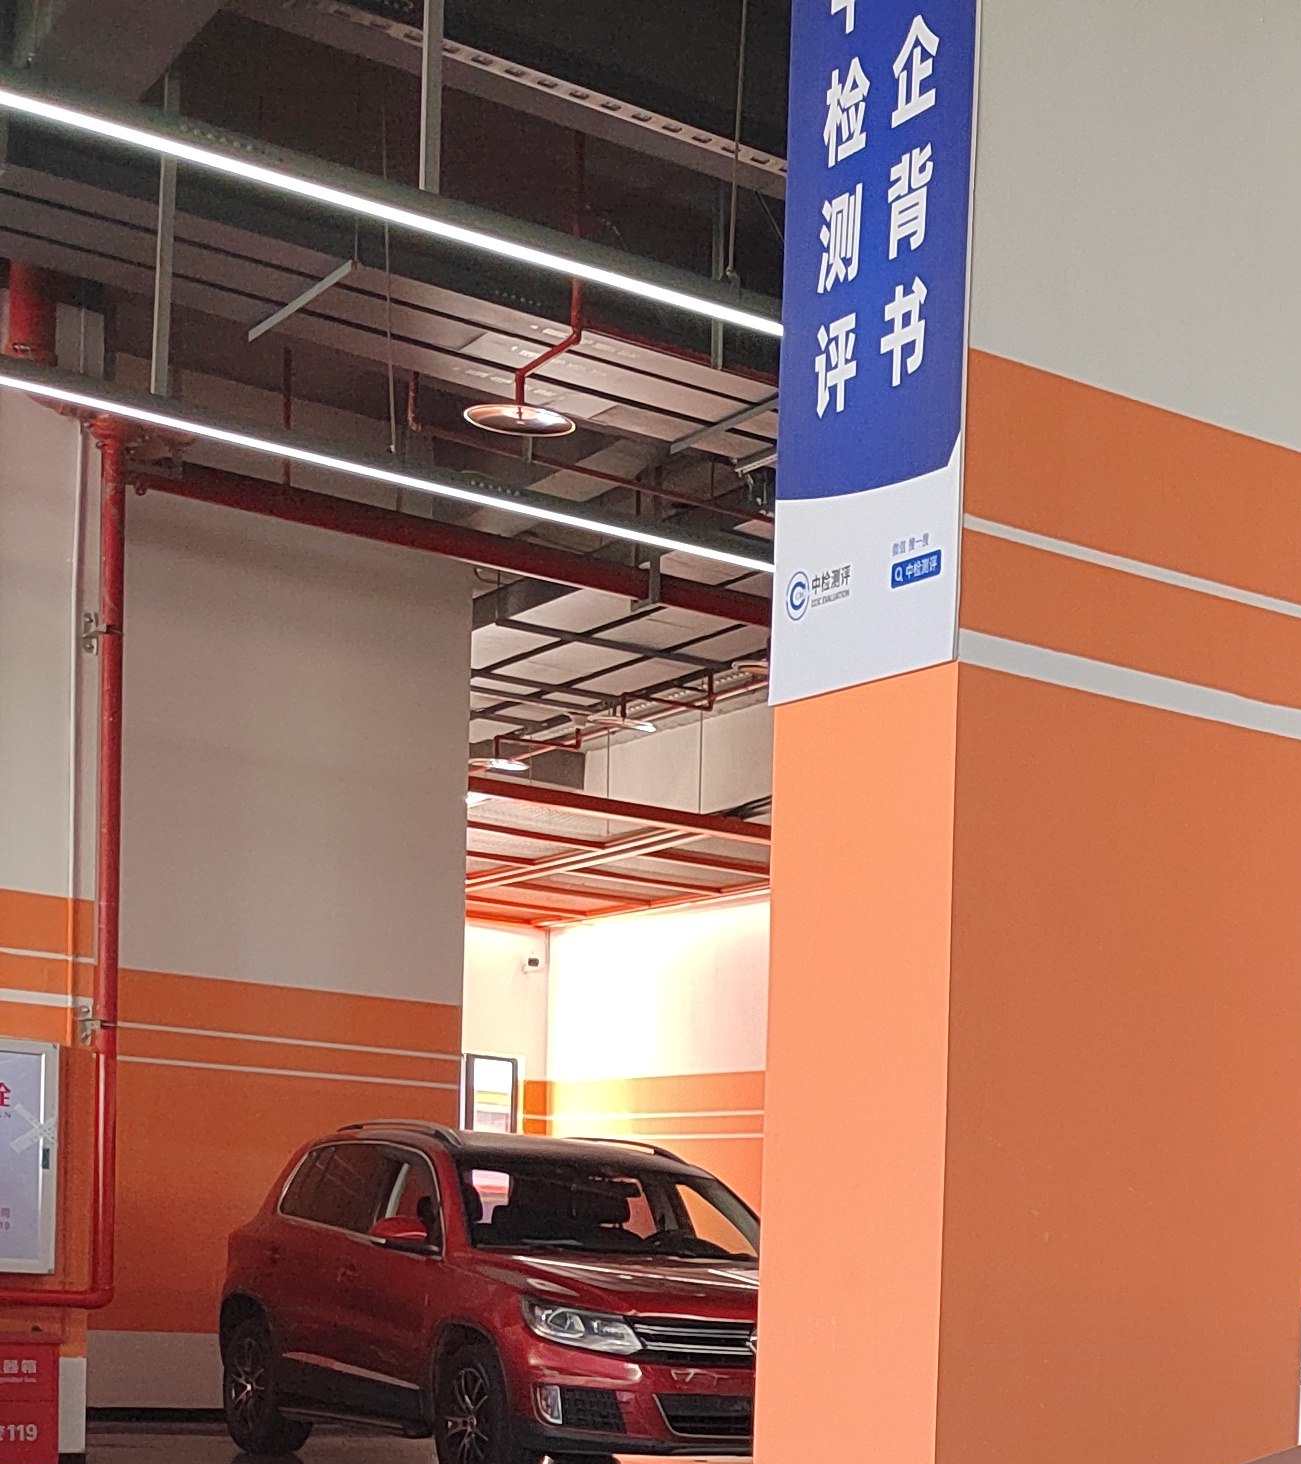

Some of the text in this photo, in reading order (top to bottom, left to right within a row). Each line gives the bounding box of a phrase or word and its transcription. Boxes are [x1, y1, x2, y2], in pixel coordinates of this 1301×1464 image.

[881, 14, 940, 386] 企背书
[812, 565, 850, 594] 中检测评
[906, 556, 937, 578] 中检测评
